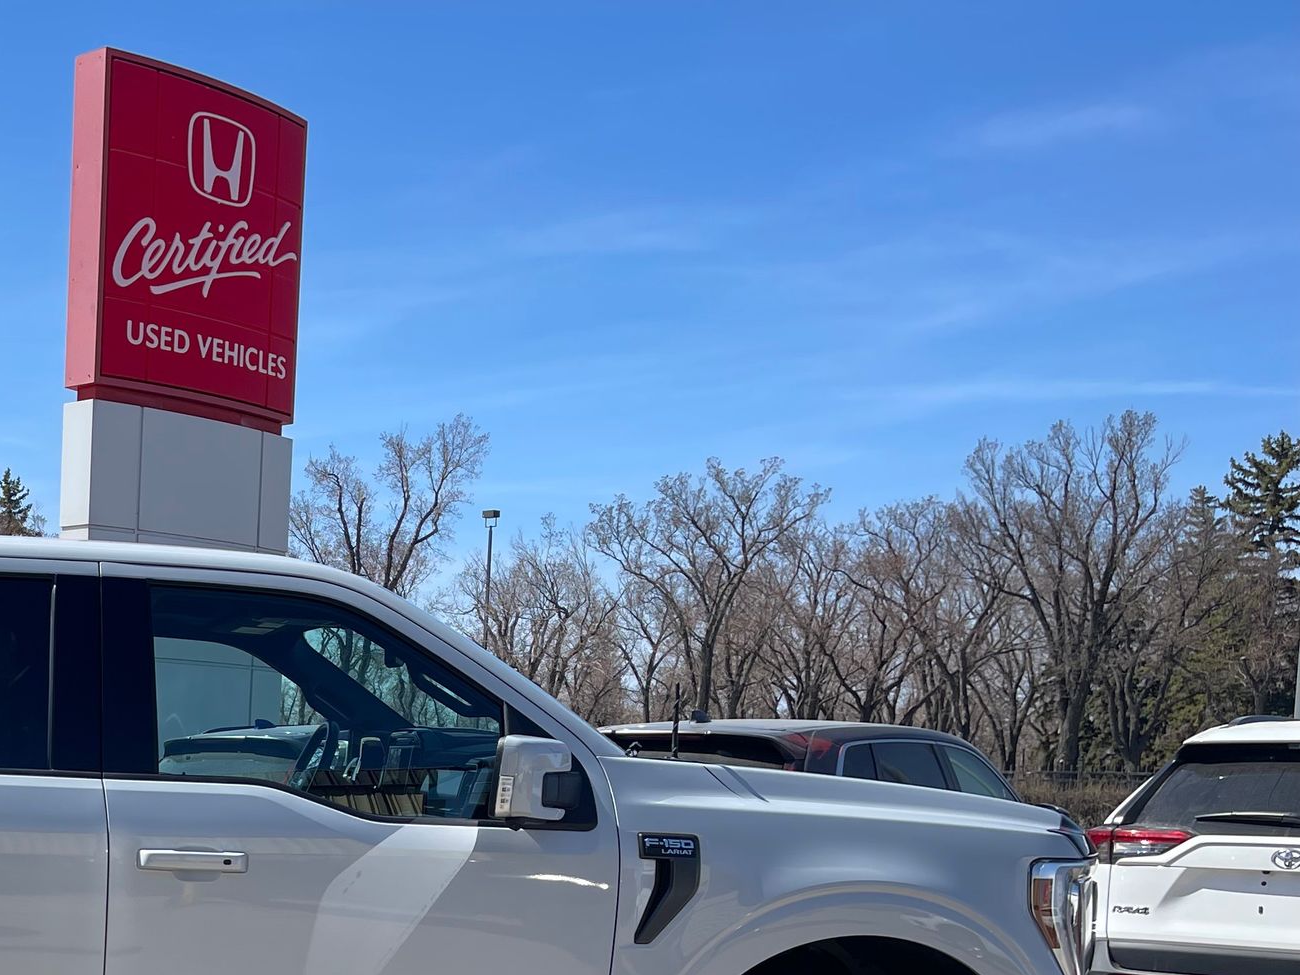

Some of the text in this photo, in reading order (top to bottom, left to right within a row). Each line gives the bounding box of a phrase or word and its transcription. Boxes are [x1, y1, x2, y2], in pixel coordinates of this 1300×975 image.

[112, 216, 298, 298] Certified
[126, 319, 287, 379] USED VEHICLES
[644, 838, 694, 849] F-150
